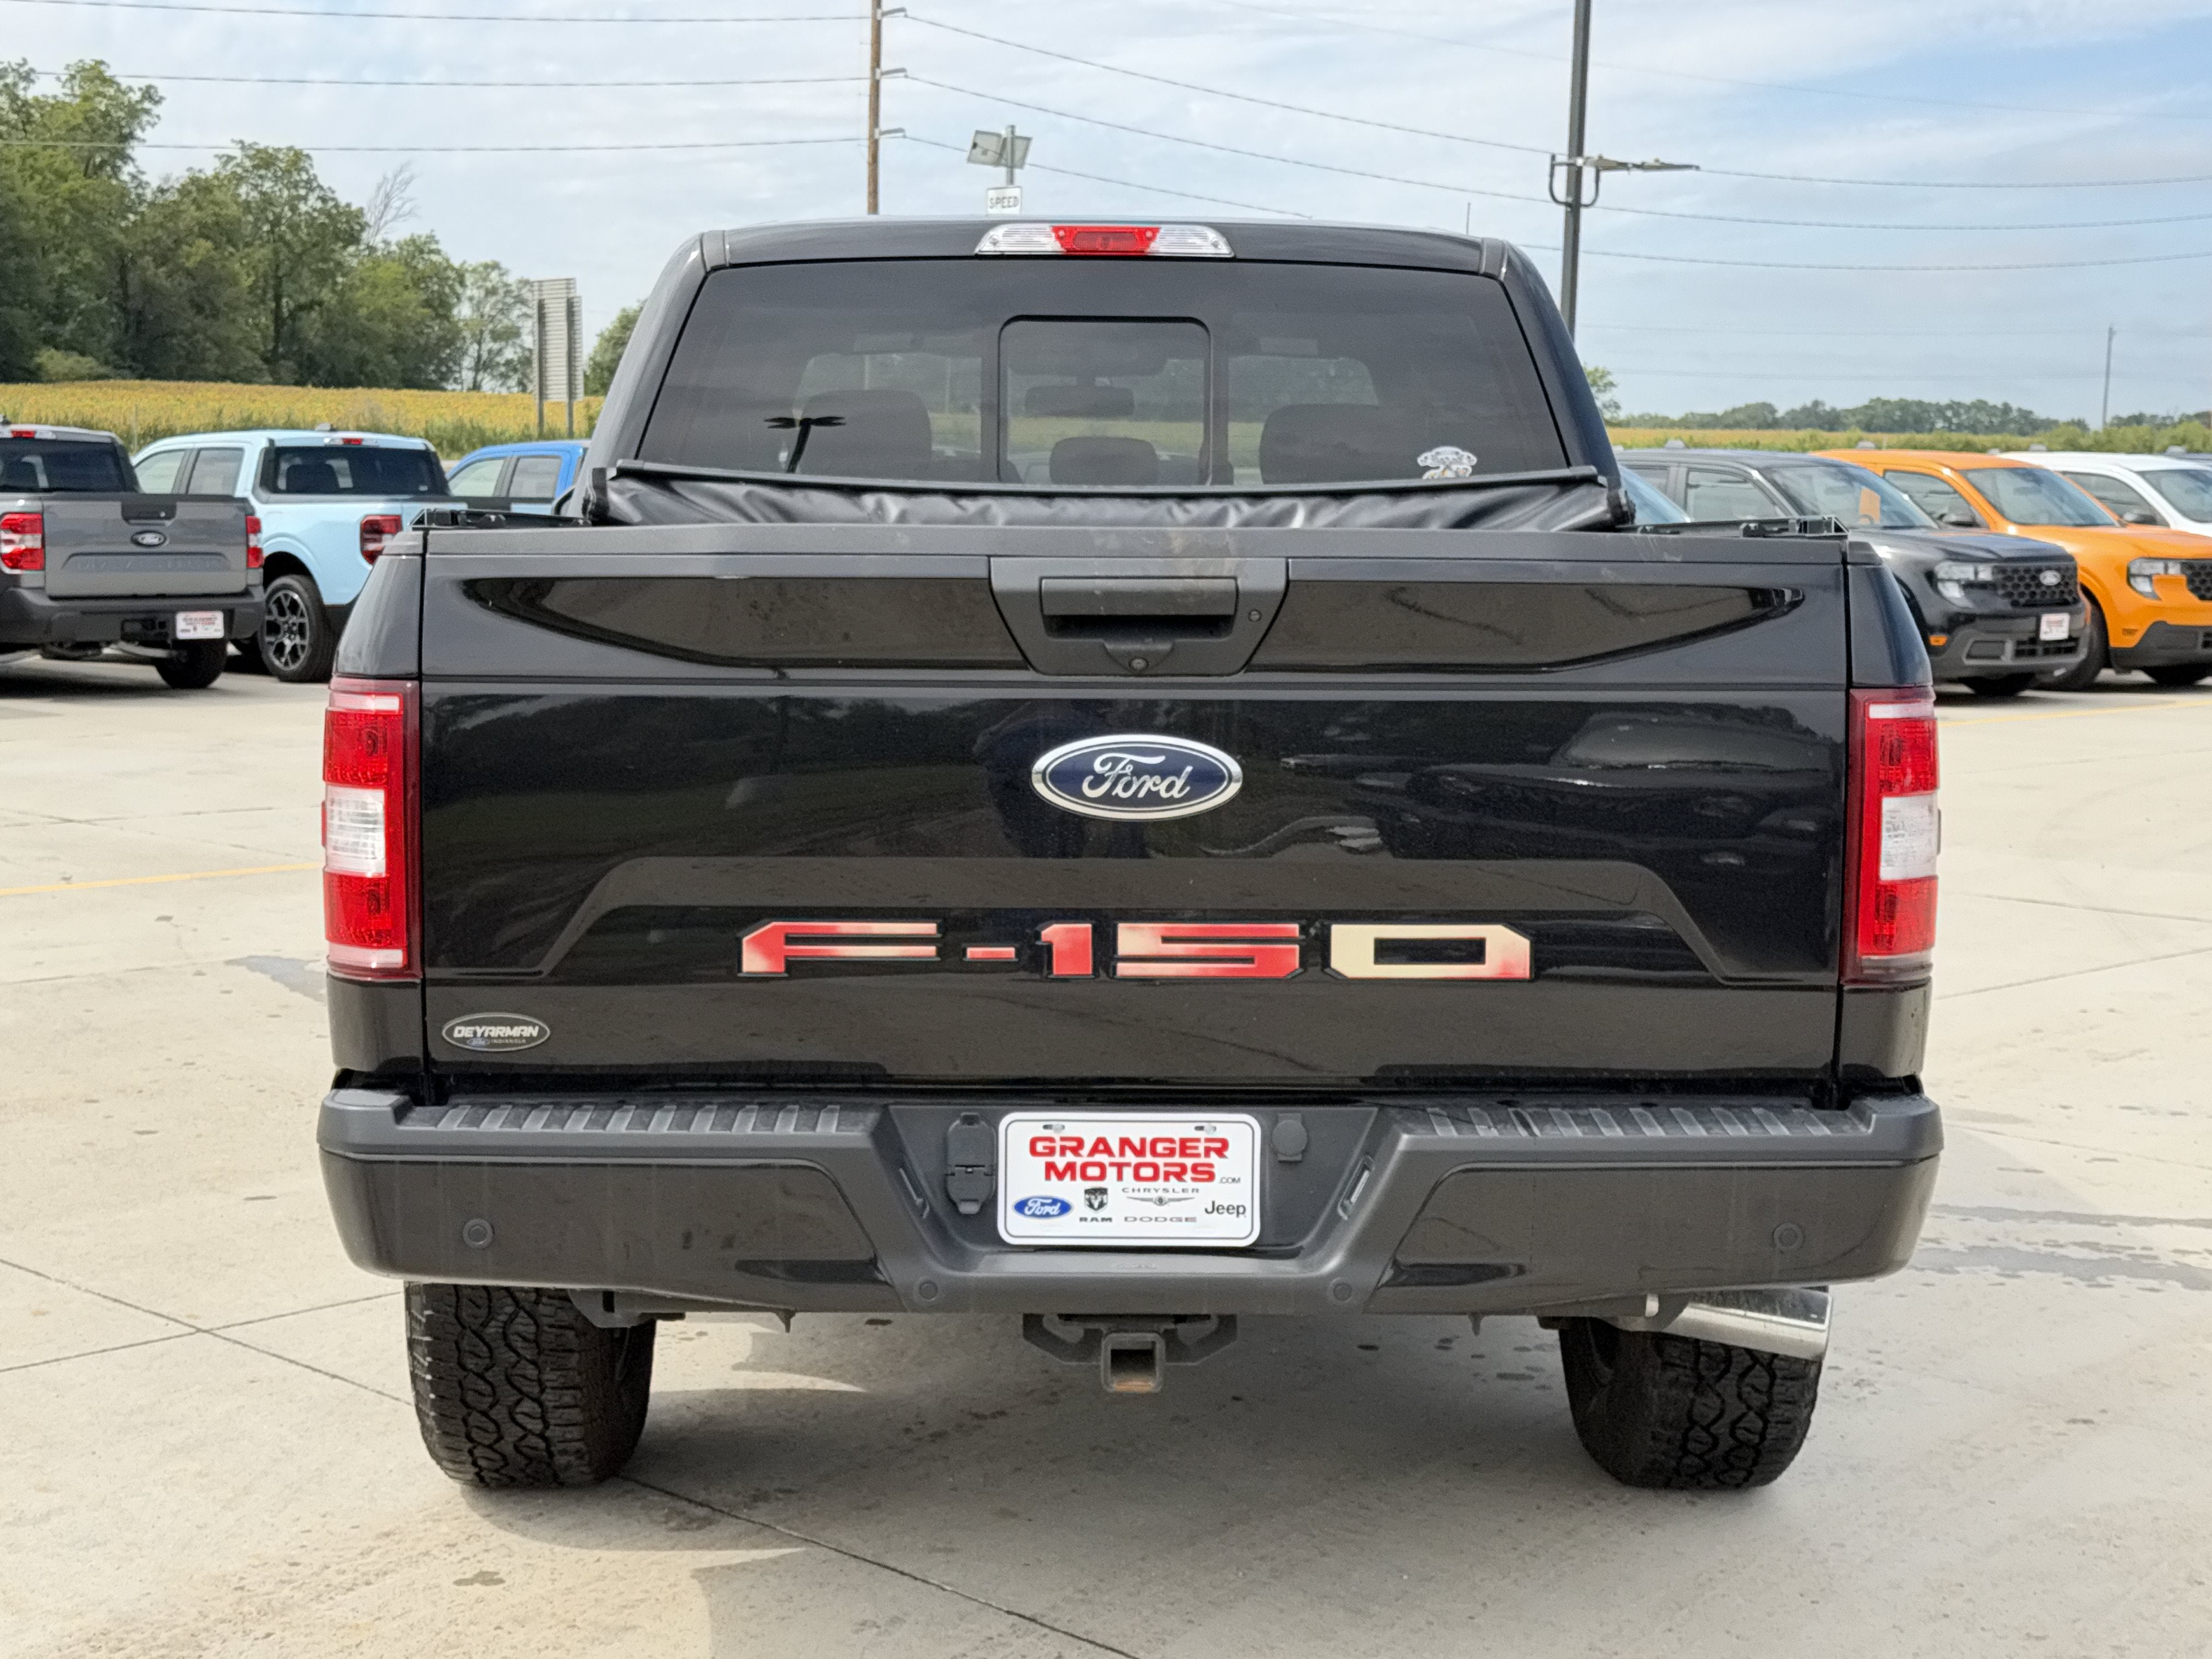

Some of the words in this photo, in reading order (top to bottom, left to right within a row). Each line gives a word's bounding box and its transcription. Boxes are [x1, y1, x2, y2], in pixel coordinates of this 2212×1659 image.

[990, 196, 1019, 209] SPEED
[1082, 752, 1194, 799] Ford
[742, 921, 1532, 980] F-150
[453, 1025, 539, 1038] DEYARMAN
[1029, 1136, 1229, 1158] GRANGER
[1045, 1161, 1216, 1183] MOTORS
[1024, 1199, 1062, 1215] Ford
[1203, 1200, 1246, 1218] Jeep
